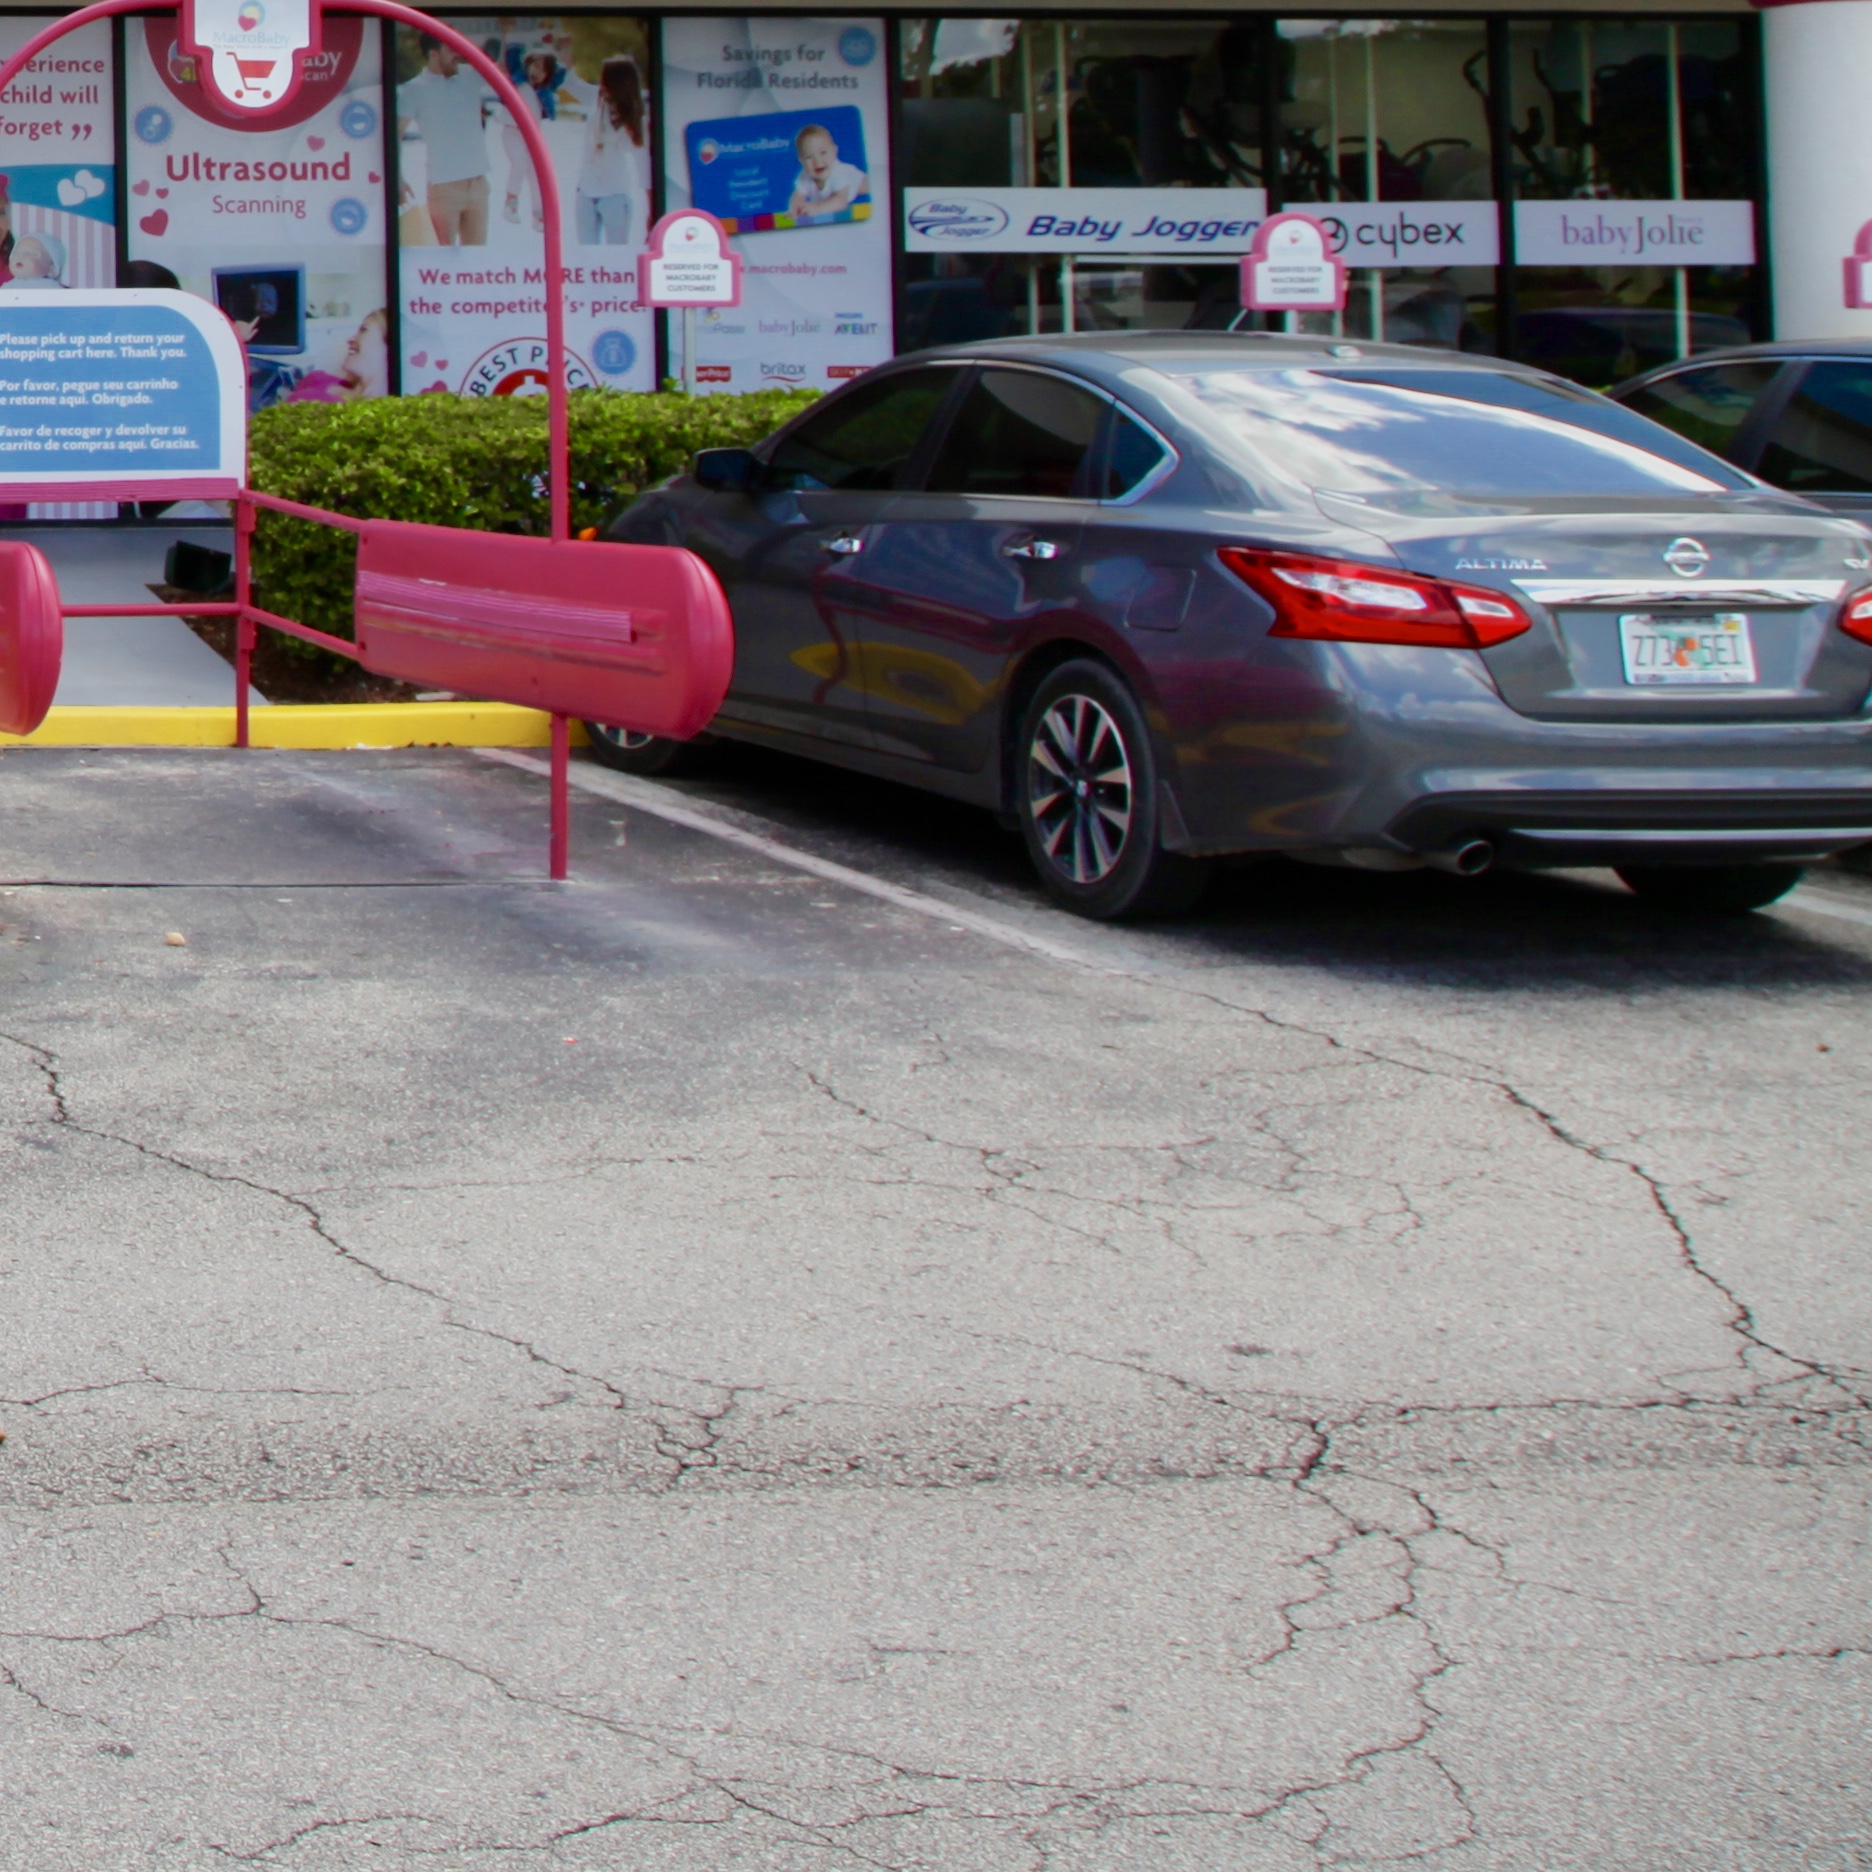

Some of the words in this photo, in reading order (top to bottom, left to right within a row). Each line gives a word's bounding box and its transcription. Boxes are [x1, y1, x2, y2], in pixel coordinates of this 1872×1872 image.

[213, 31, 291, 46] MacroBaby
[722, 45, 791, 66] Savings
[797, 44, 825, 61] for
[697, 72, 763, 89] Florida
[768, 72, 859, 89] Residents
[0, 85, 52, 104] child
[60, 85, 99, 104] will
[166, 151, 350, 182] Ultrasound
[212, 195, 306, 220] Scanning
[929, 203, 968, 214] Baby
[1027, 215, 1122, 242] Baby
[1131, 215, 1261, 242] Jogger
[1356, 211, 1465, 258] cybex
[418, 268, 451, 285] We
[455, 266, 516, 284] match
[523, 268, 585, 284] MRE
[591, 265, 636, 284] than
[409, 296, 442, 315] the
[0, 333, 38, 345] Please
[40, 333, 67, 347] pick
[69, 335, 85, 347] up
[88, 333, 112, 345] and
[114, 334, 154, 344] return
[157, 334, 185, 346] your
[0, 347, 56, 362] shopping
[58, 348, 82, 358] cart
[86, 347, 117, 358] here.
[120, 346, 158, 358] Thank
[160, 348, 187, 361] you.
[470, 347, 519, 396] BEST
[760, 362, 806, 375] britax
[0, 380, 20, 391] Por
[23, 379, 60, 392] favor,
[62, 380, 100, 394] pegue
[103, 380, 124, 390] seu
[126, 378, 179, 390] carrinho
[0, 396, 7, 405] e
[9, 395, 56, 405] retorne
[59, 394, 88, 408] aqui.
[91, 392, 153, 408] Obrigado.
[0, 425, 34, 437] Favor
[37, 425, 52, 437] de
[55, 426, 102, 439] recoger
[105, 426, 113, 438] y
[115, 423, 170, 436] devolver
[172, 425, 187, 435] su
[0, 439, 42, 451] carrito
[44, 439, 60, 451] de
[62, 440, 116, 454] compras
[150, 437, 200, 450] Gracias.
[1455, 557, 1548, 571] ALTIMA
